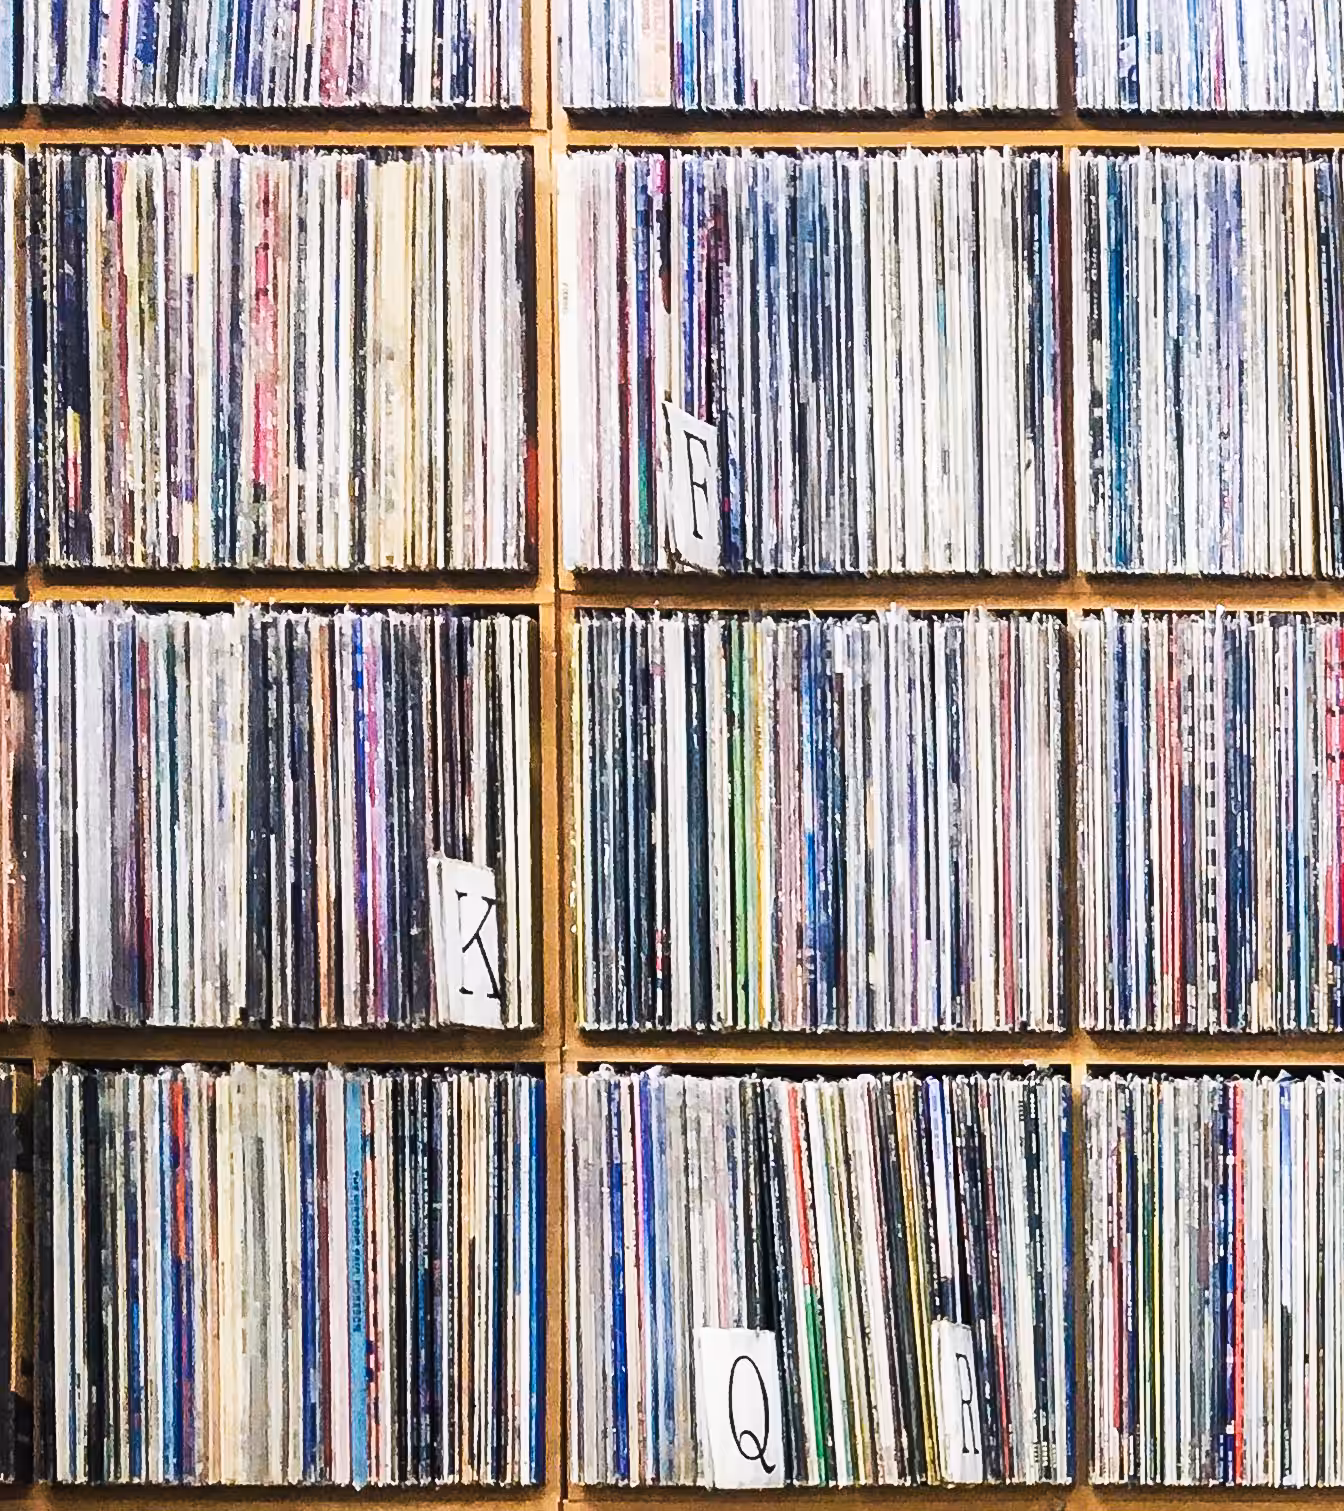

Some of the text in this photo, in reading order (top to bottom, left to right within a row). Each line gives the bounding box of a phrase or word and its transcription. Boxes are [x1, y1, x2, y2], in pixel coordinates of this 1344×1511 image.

[683, 429, 711, 540] F
[455, 889, 501, 1000] K
[728, 1355, 776, 1474] Q
[955, 1352, 980, 1455] R
